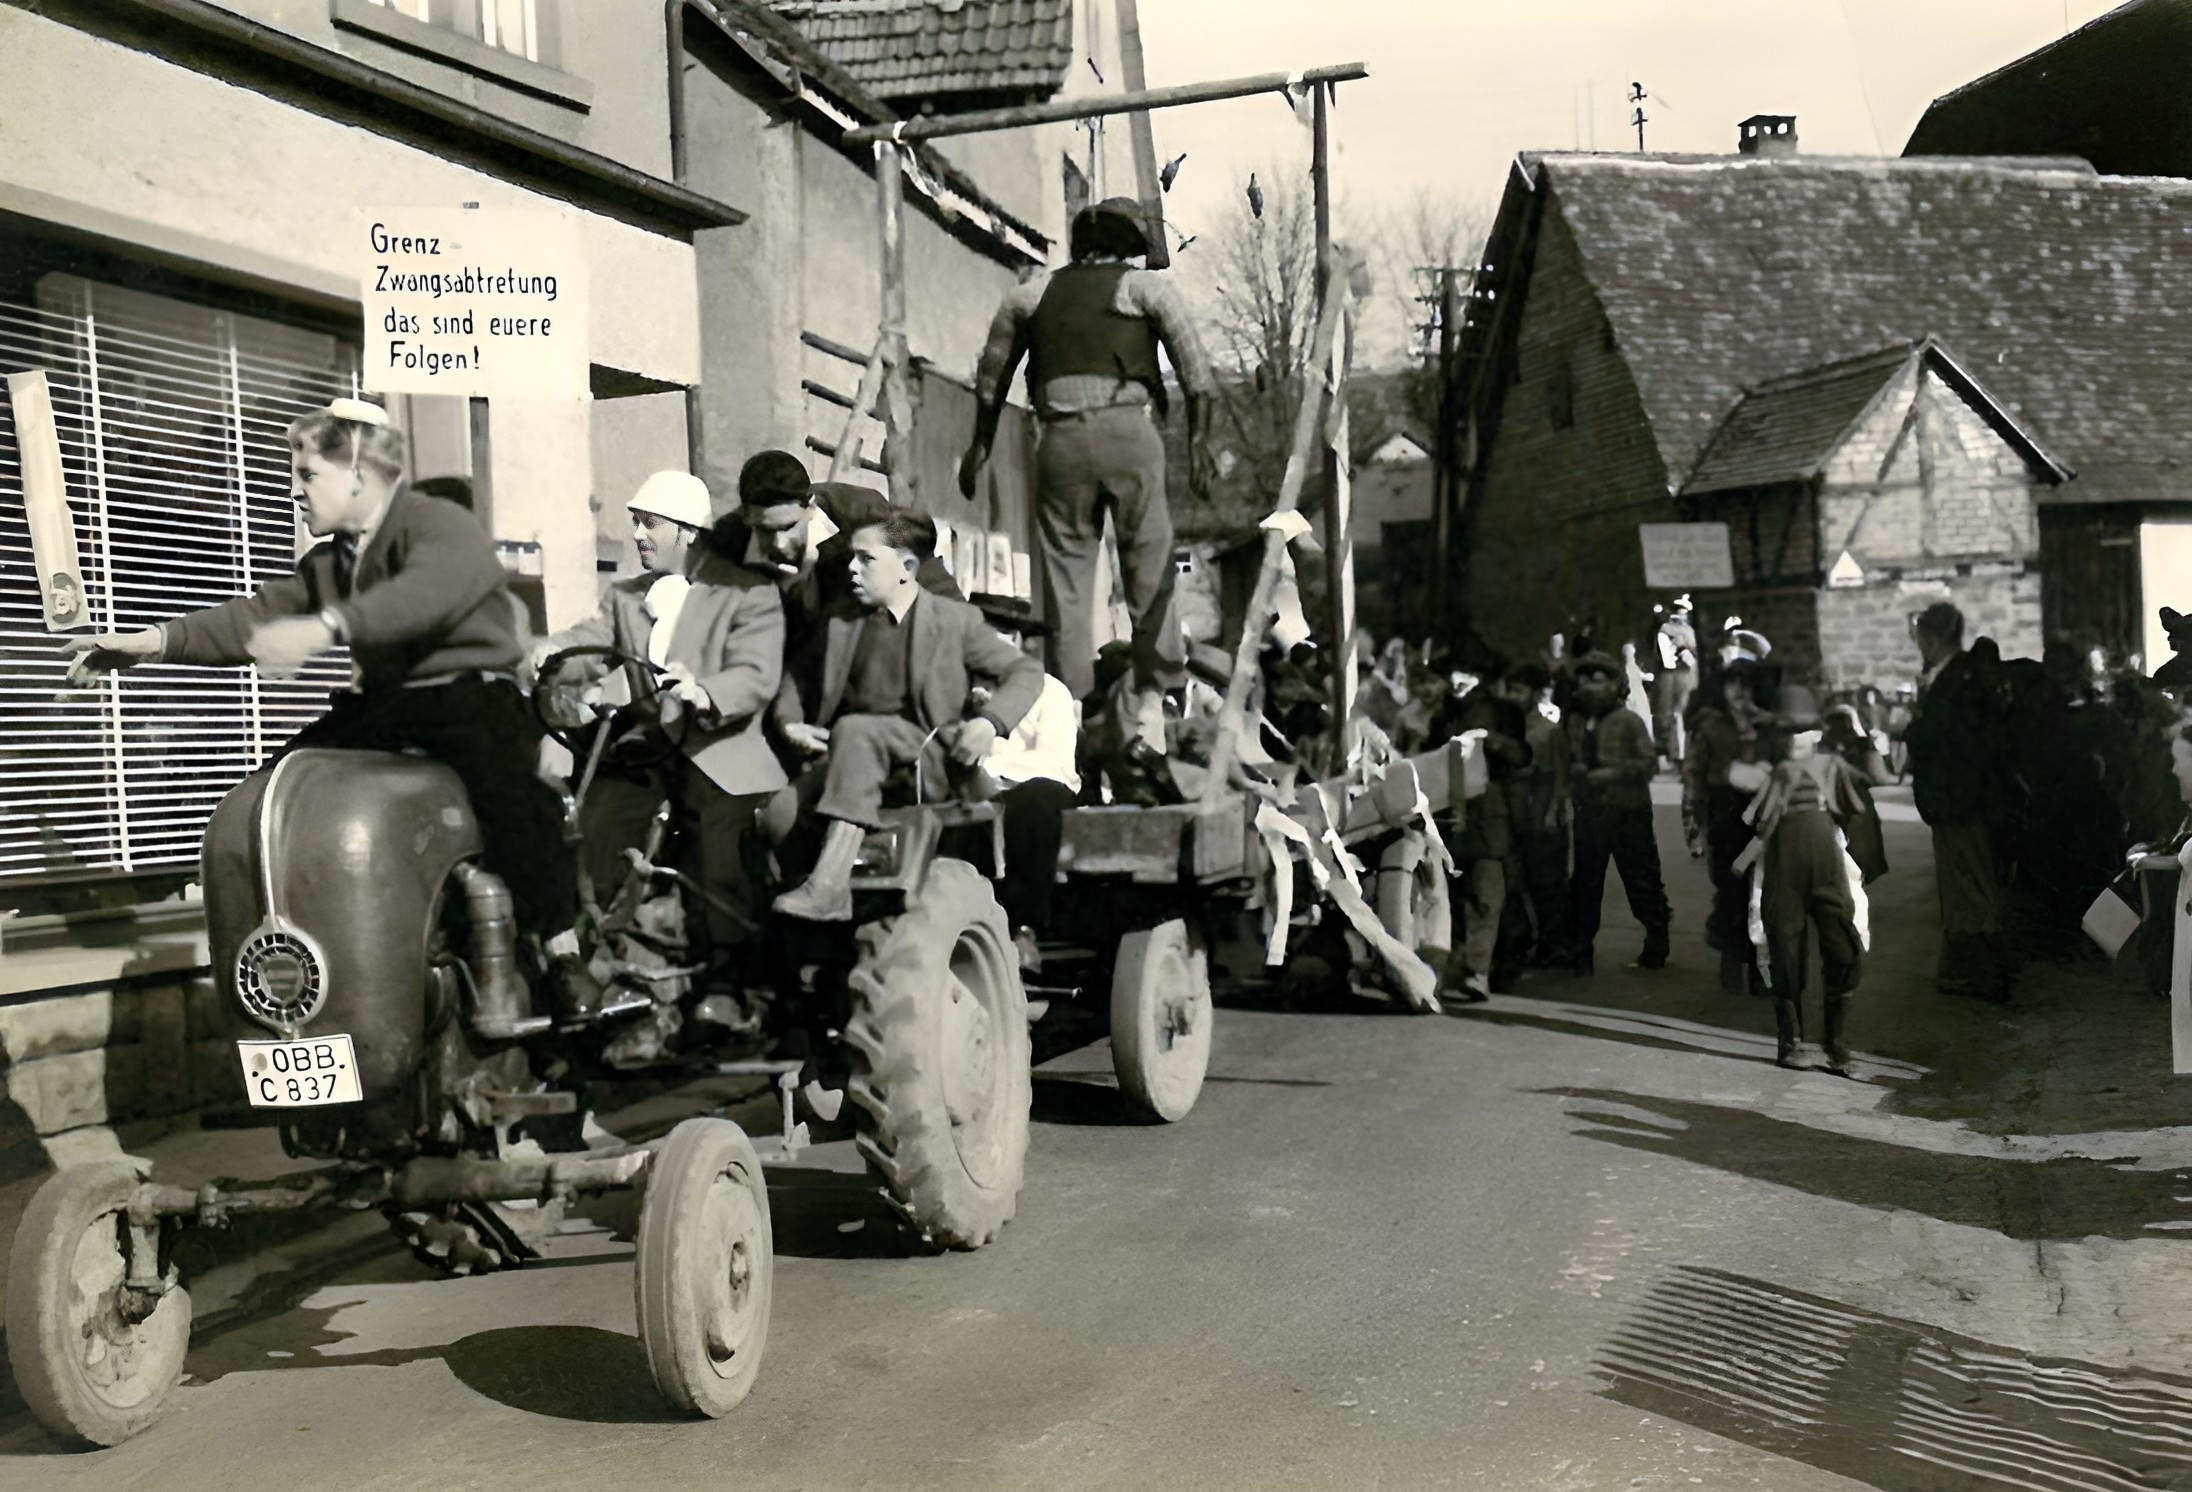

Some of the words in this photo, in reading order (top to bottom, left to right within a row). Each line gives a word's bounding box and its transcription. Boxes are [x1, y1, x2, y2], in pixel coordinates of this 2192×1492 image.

[375, 264, 557, 301] Zwangsabtretung
[384, 306, 421, 334] das
[433, 308, 474, 335] sind
[489, 316, 551, 336] euere
[390, 340, 481, 375] Folgen!
[260, 1077, 278, 1102] C
[286, 1073, 337, 1102] 837
